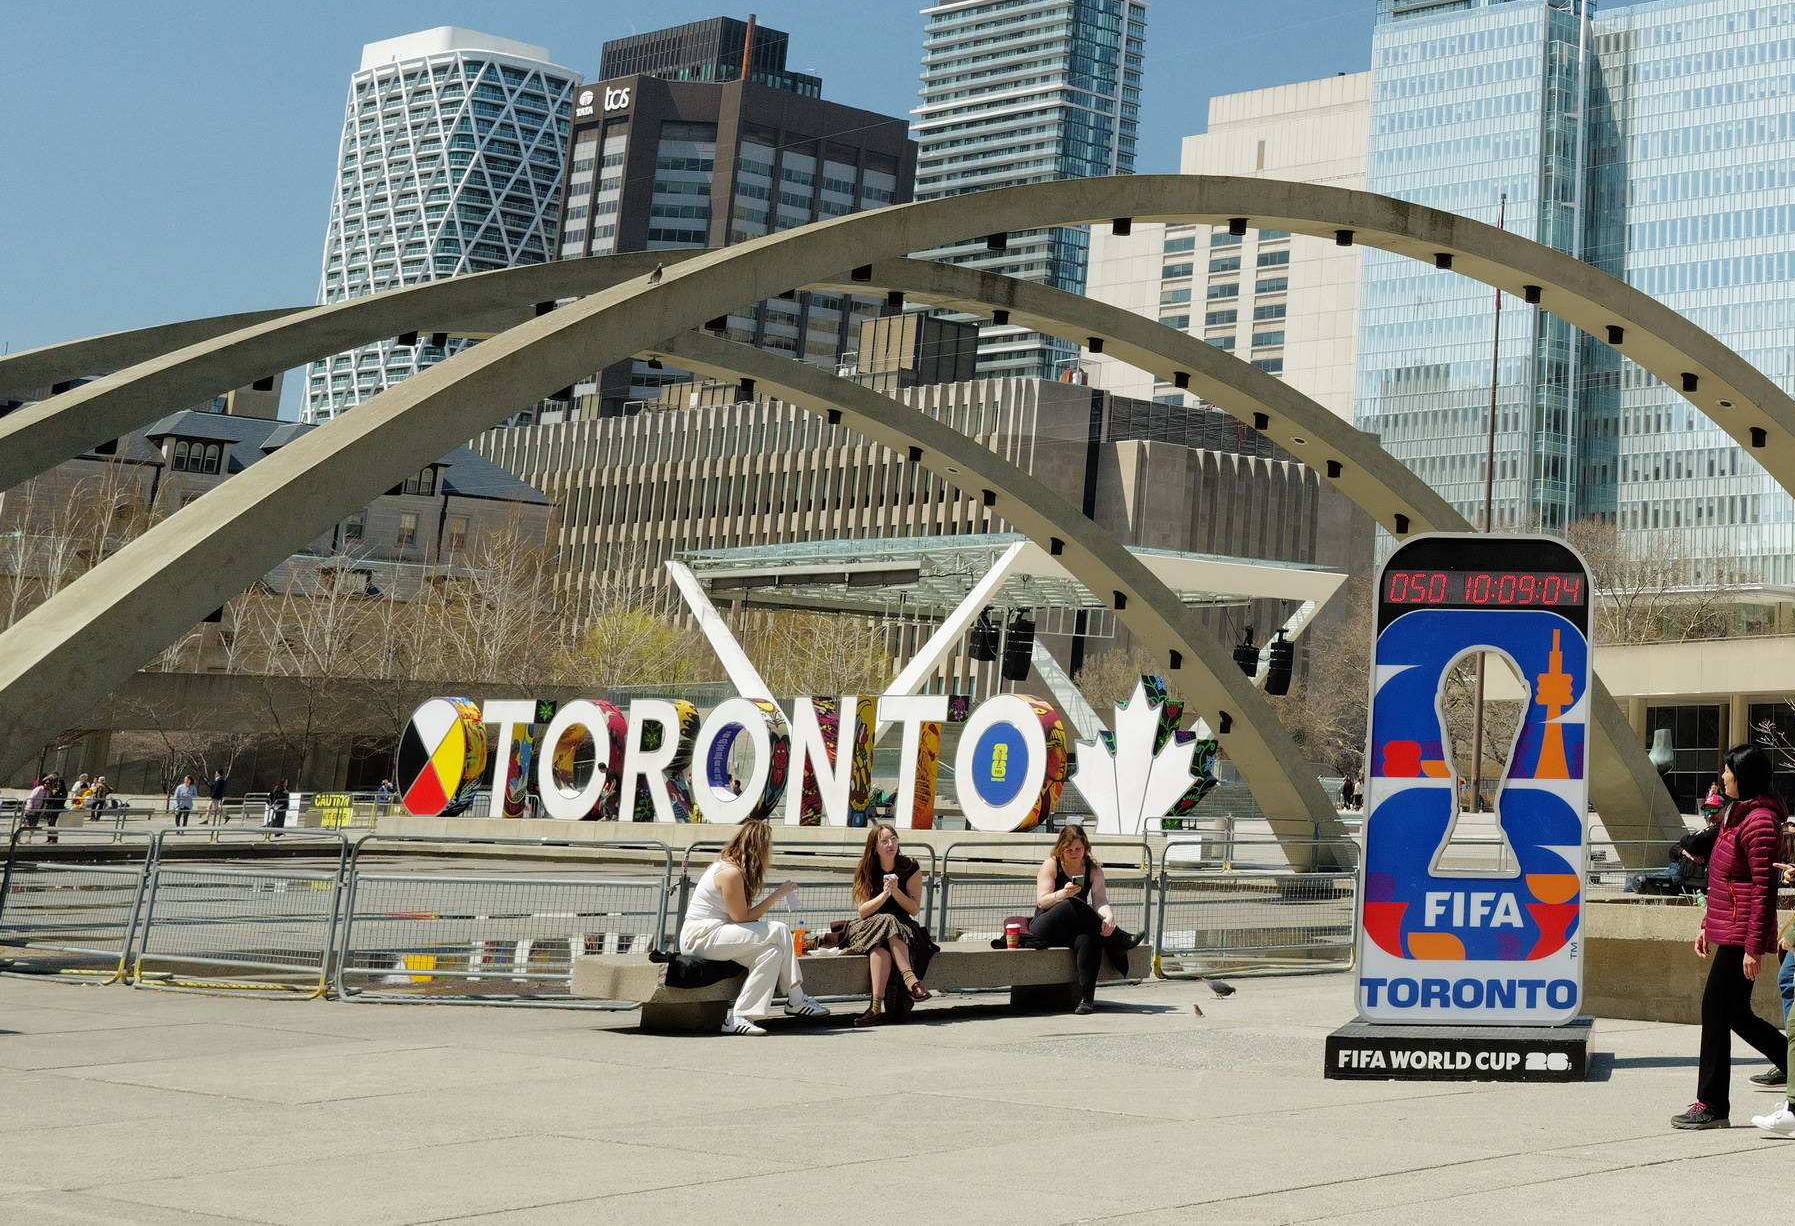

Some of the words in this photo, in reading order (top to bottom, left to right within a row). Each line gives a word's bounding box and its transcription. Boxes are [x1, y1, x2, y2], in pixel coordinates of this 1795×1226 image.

[576, 106, 593, 117] TATA
[604, 86, 630, 111] tcs
[1390, 573, 1447, 603] 050
[1464, 574, 1581, 605] 10:09:04
[482, 693, 1048, 832] TORONTO
[1424, 891, 1524, 928] FIFA
[1570, 942, 1578, 960] TM
[1360, 977, 1578, 1010] TORONTO
[1338, 1050, 1387, 1069] FIFA
[1389, 1050, 1472, 1071] WORLD
[1475, 1051, 1521, 1071] CUP
